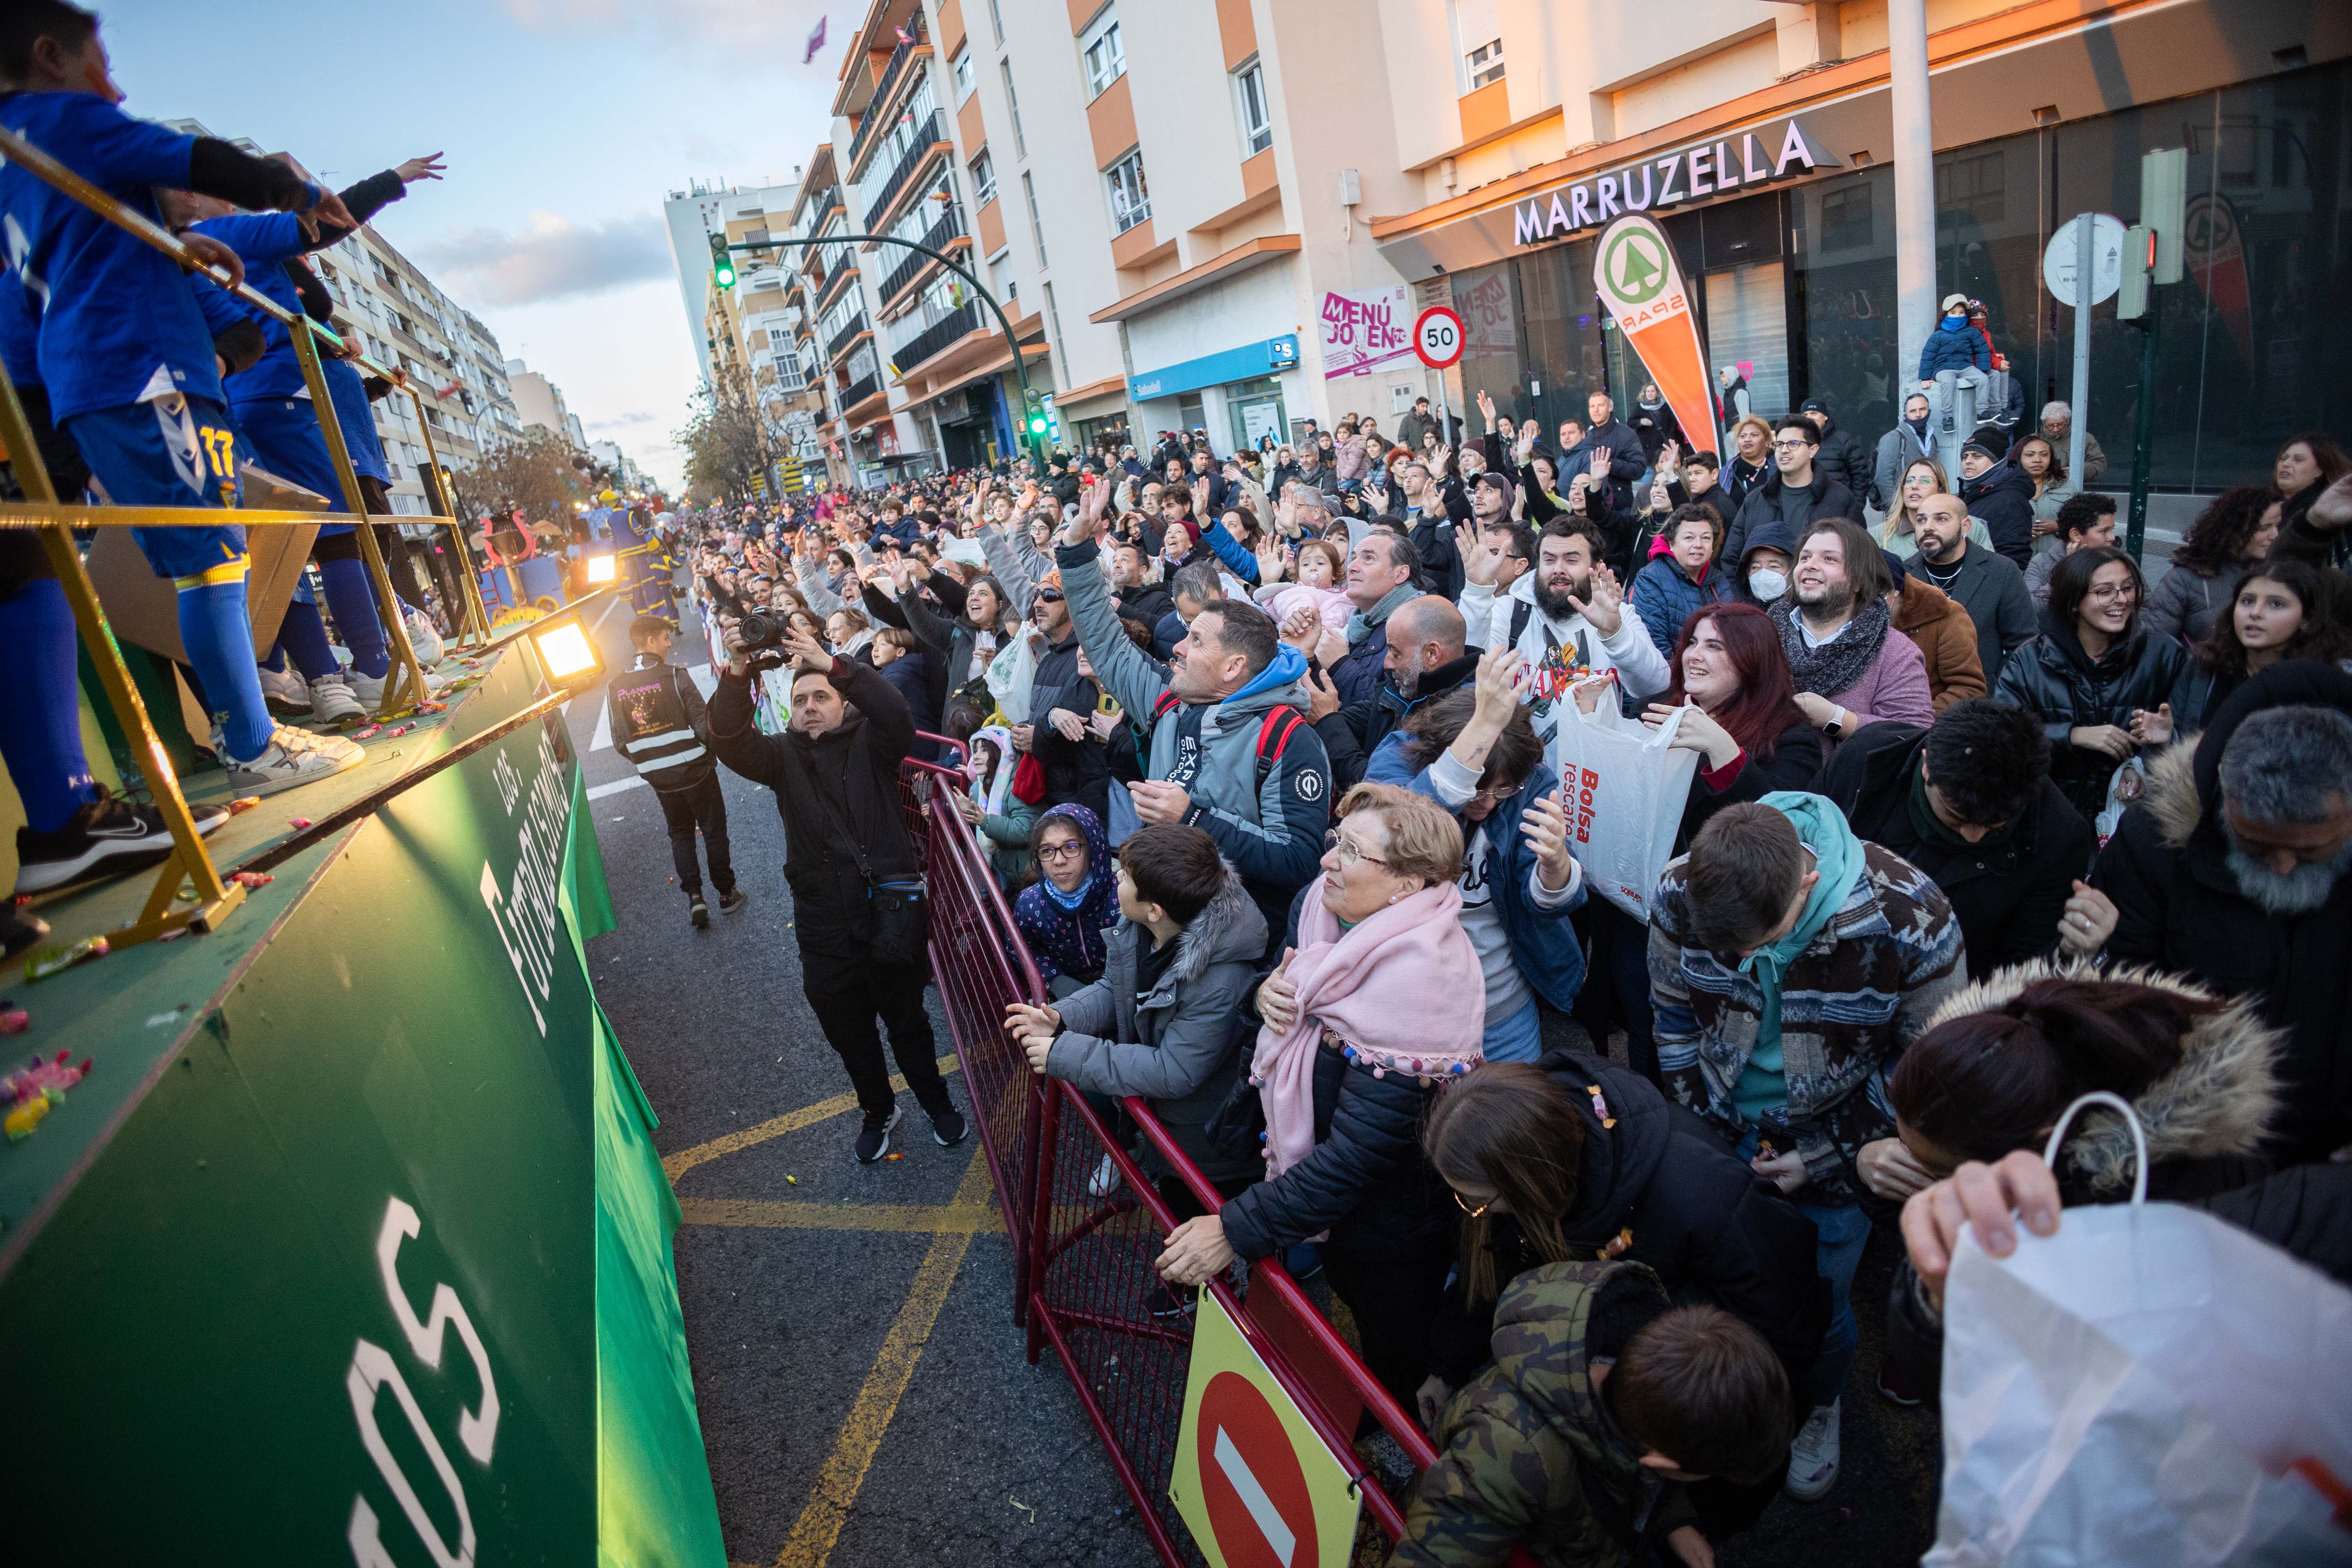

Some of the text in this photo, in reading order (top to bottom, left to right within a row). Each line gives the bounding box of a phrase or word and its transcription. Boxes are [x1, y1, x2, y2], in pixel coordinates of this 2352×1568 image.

[1514, 119, 1814, 245] MARRUZELLA
[1325, 297, 1391, 327] MENÚ
[1427, 327, 1453, 347] 50
[200, 427, 235, 478] 17
[618, 683, 661, 698] PLANNING
[492, 747, 519, 817] LOS
[1562, 763, 1577, 835] rescate
[1577, 768, 1599, 844] Bolsa
